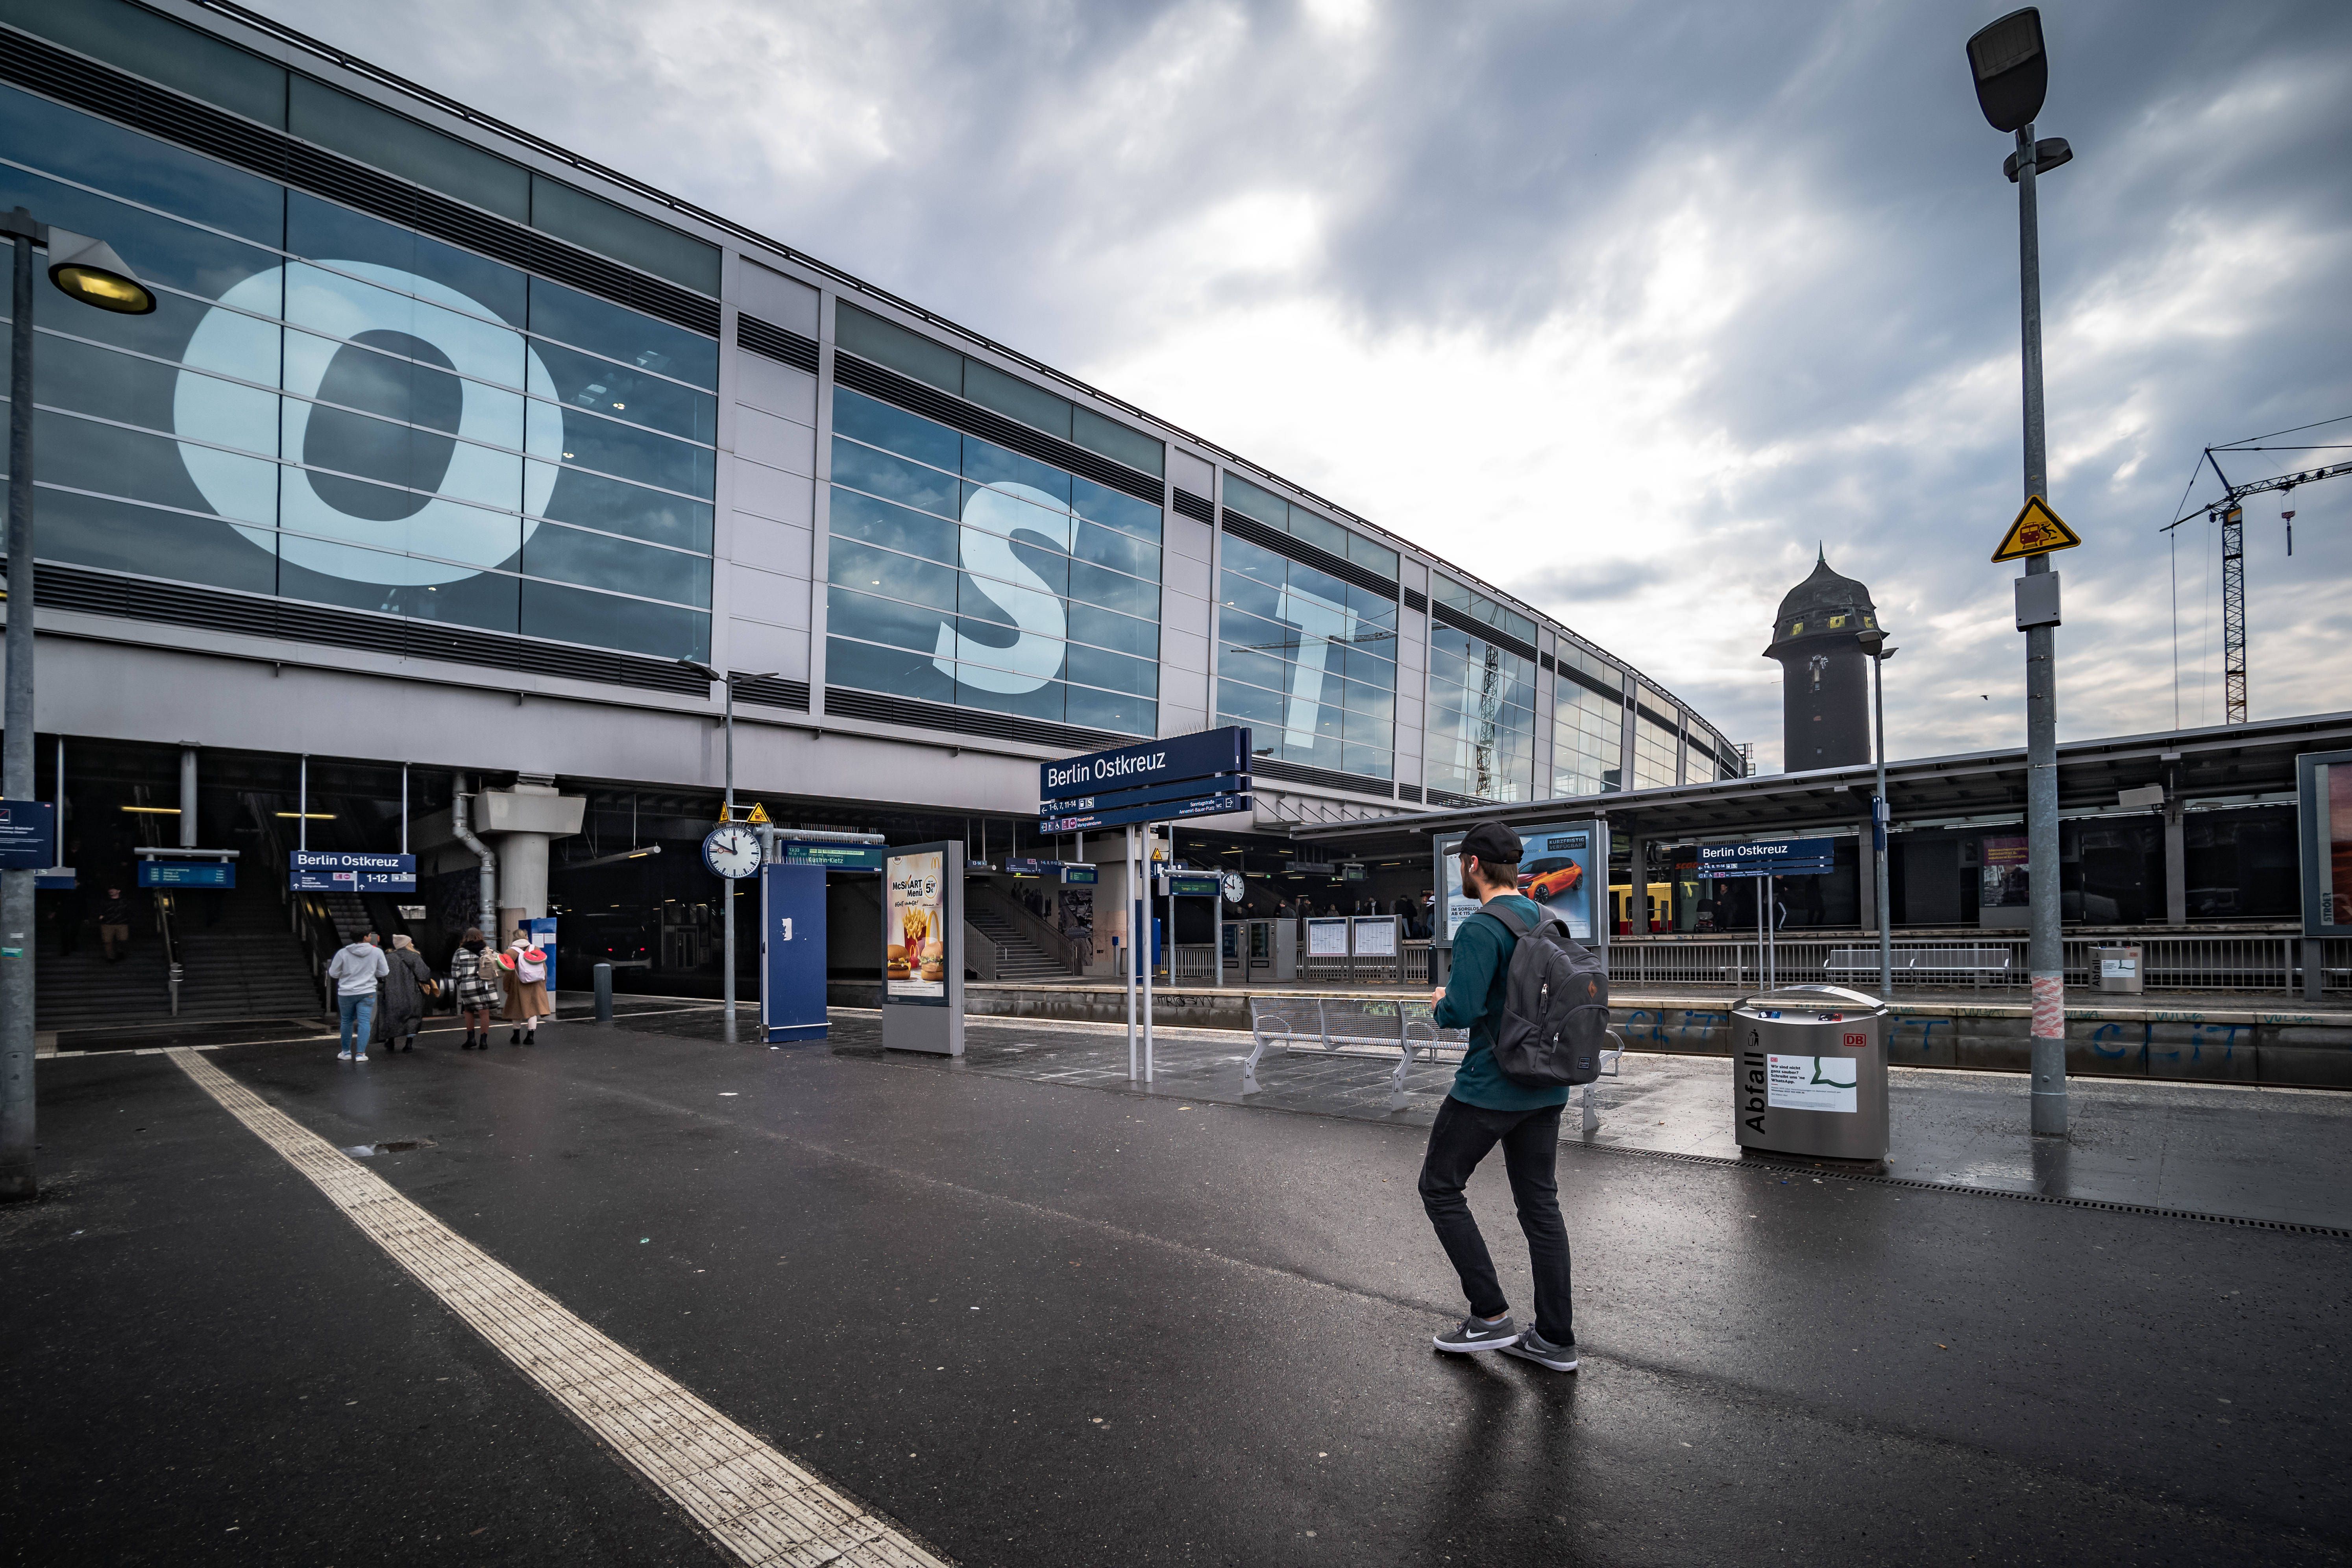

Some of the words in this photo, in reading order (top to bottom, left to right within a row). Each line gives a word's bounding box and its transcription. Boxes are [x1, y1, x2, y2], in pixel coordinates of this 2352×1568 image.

[1048, 763, 1089, 787] Berlin
[1095, 752, 1165, 779] Ostkreuz
[1703, 847, 1734, 858] Berlin
[1738, 845, 1788, 856] Ostkreuz
[298, 854, 337, 865] Berlin
[342, 856, 399, 867] Ostkreuz
[367, 874, 388, 883] 1-12
[907, 888, 923, 897] Menü
[1744, 1052, 1765, 1135] Abfall
